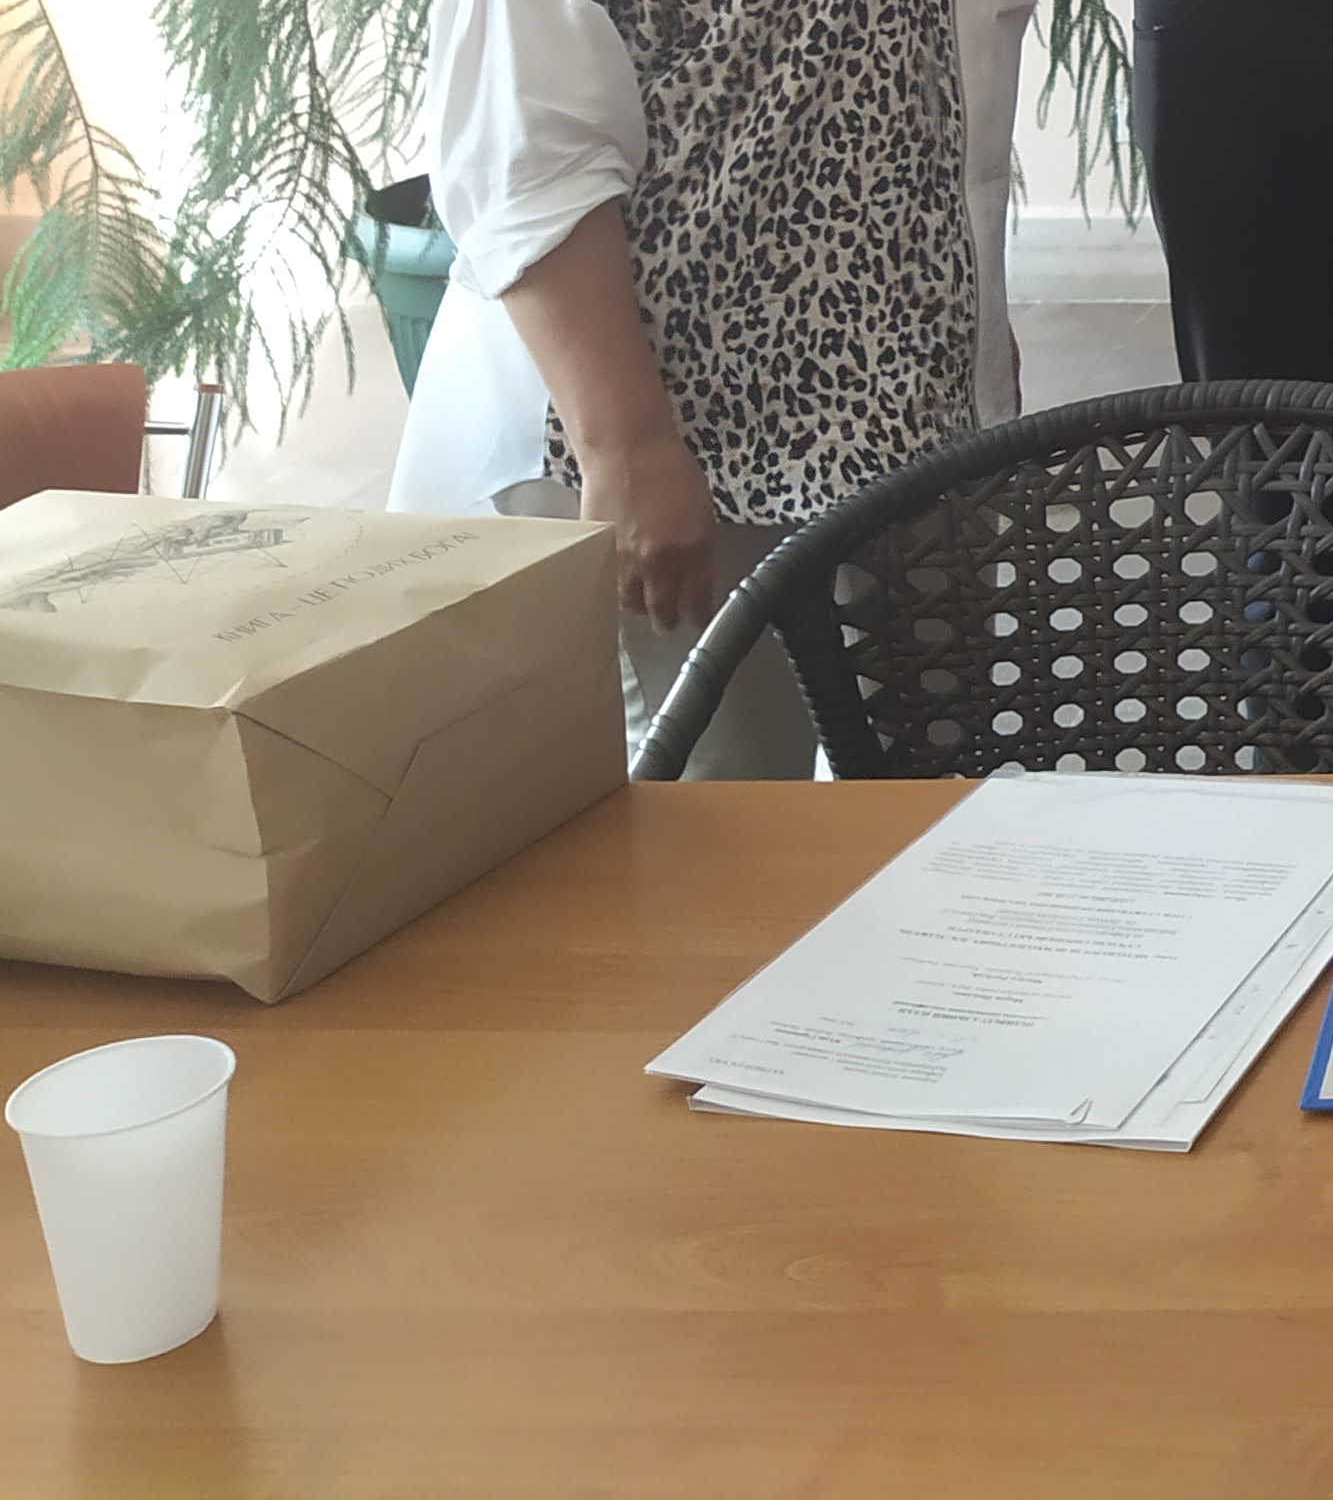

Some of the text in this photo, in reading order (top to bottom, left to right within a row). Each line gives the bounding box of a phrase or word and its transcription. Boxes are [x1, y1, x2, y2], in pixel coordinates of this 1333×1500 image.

[213, 611, 296, 643] КНИГА
[297, 587, 341, 606] ЦЕ
[330, 557, 422, 590] ПОДИХ
